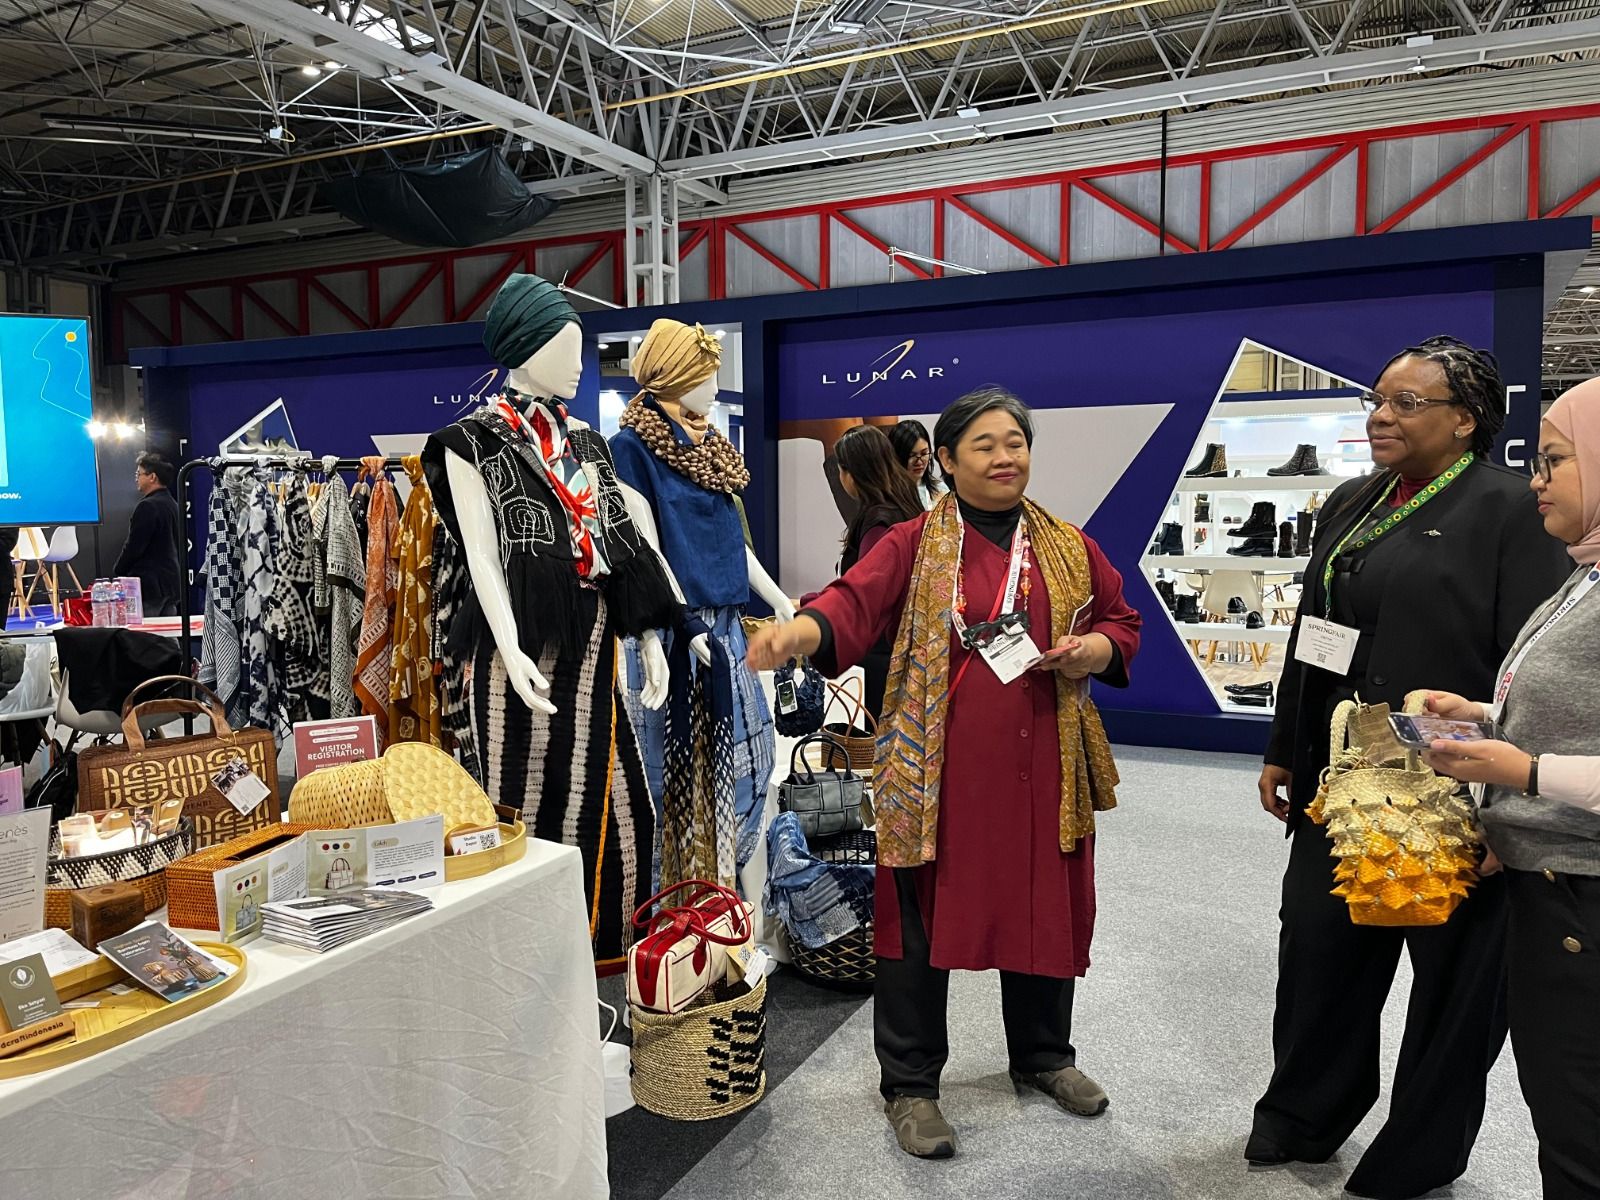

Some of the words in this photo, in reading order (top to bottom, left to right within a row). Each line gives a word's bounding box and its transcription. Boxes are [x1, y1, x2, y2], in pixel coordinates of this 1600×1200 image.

[822, 367, 944, 385] LUNAR
[1308, 623, 1346, 639] SPRINGFAIR
[307, 748, 365, 760] REGISTRATION
[320, 743, 352, 752] VISITOR
